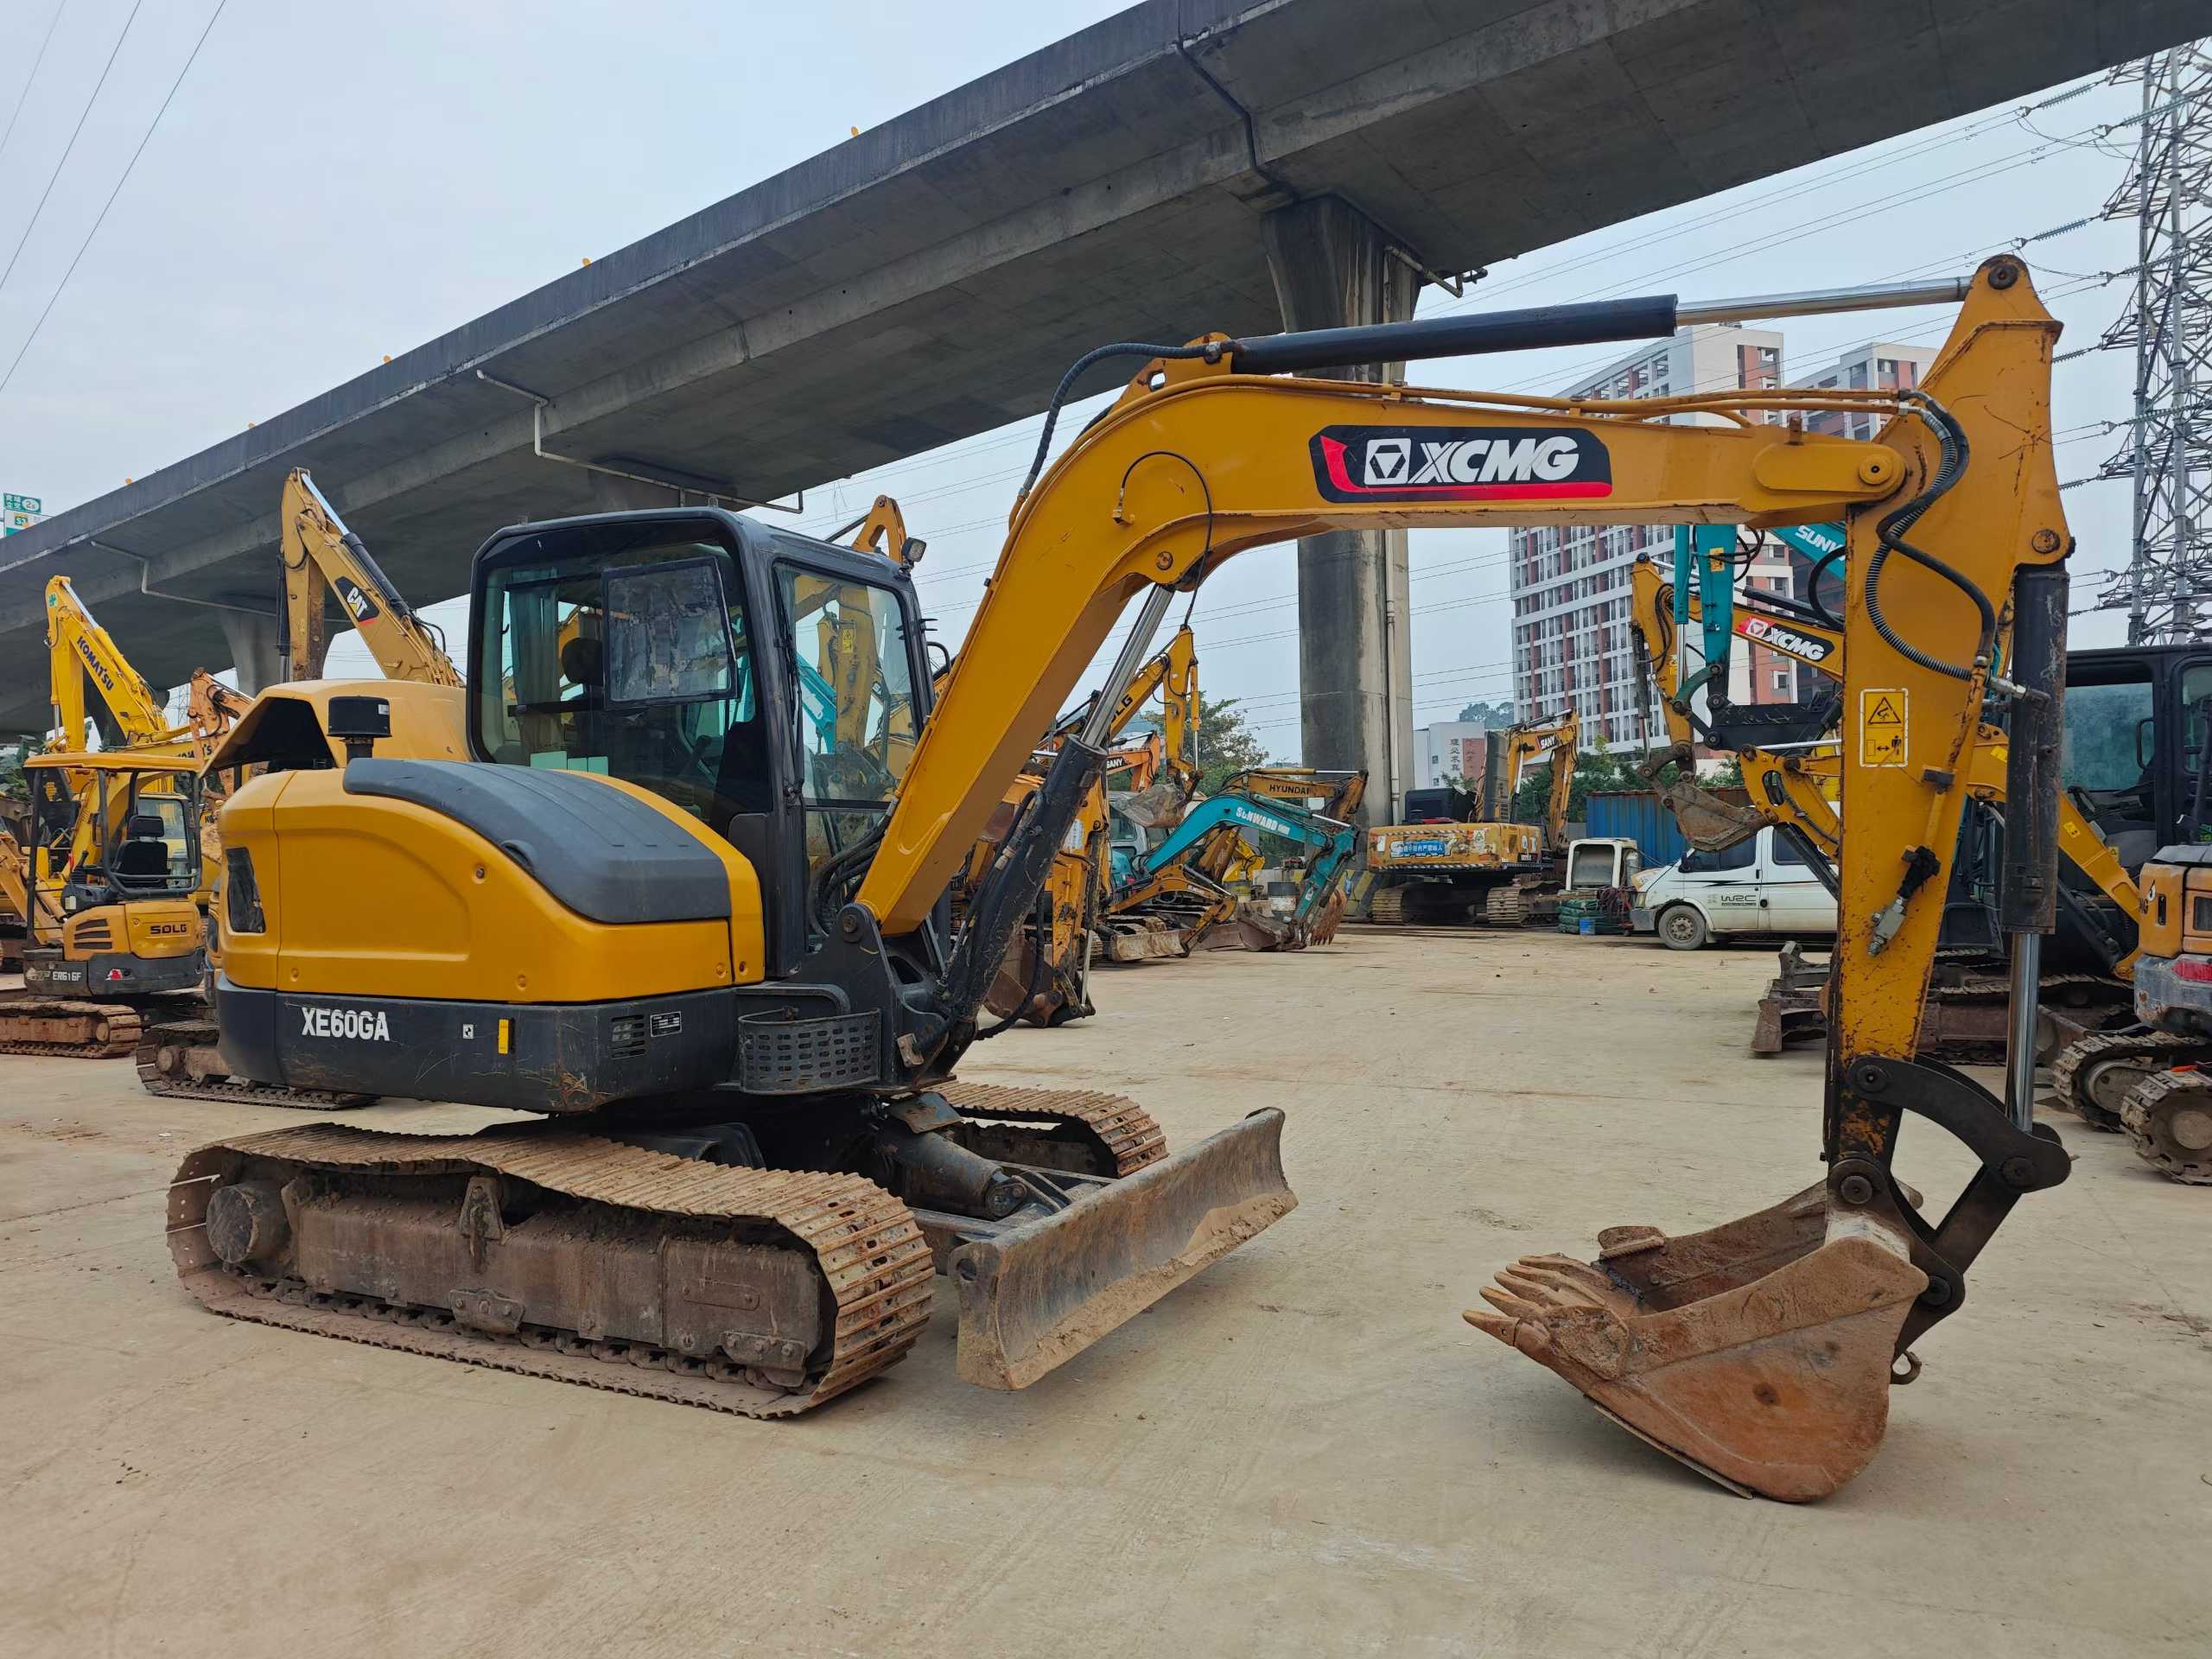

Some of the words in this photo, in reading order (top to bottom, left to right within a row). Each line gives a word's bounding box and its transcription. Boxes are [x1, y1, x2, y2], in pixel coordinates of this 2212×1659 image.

[1408, 435, 1580, 484] XCMG
[347, 588, 368, 618] CAT
[1762, 627, 1825, 661] XCMG
[1540, 734, 1555, 749] SANY
[1268, 785, 1310, 794] HYUNDAI
[52, 971, 82, 982] ER616F
[302, 1007, 391, 1041] XE60GA
